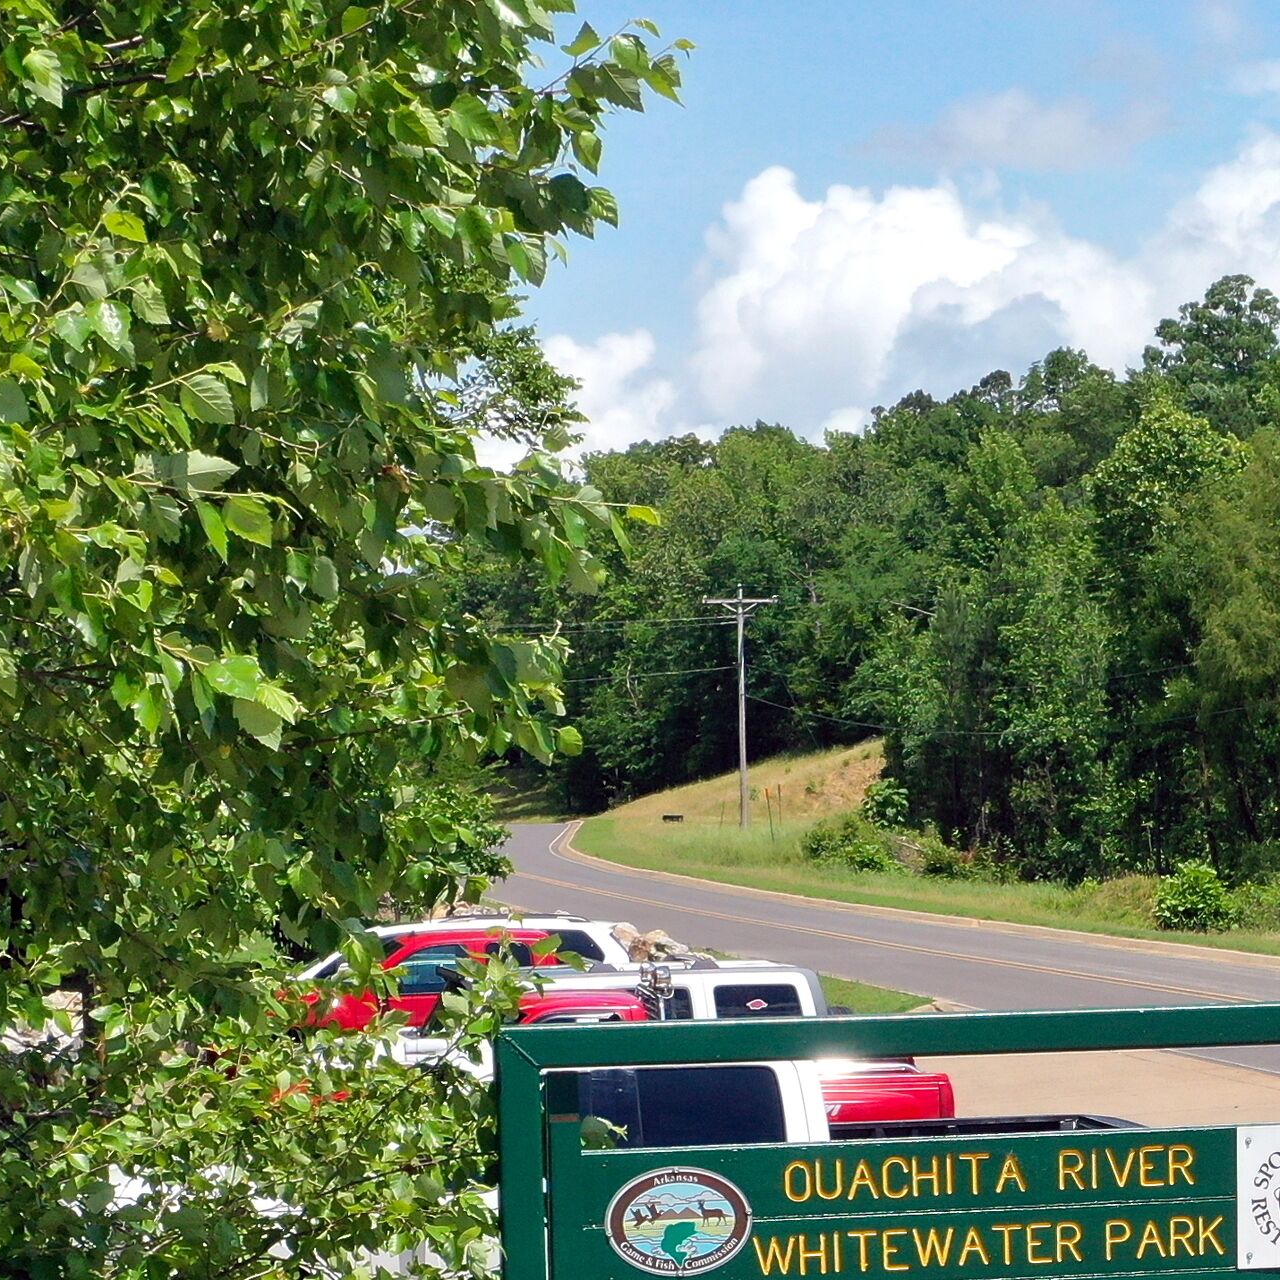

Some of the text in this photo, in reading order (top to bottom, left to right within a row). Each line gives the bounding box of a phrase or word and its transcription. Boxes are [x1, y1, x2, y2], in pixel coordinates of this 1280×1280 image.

[653, 1174, 699, 1187] Arkansas
[784, 1144, 1196, 1203] OUACHITA RIVER
[620, 1238, 738, 1270] Game & Fish Commission
[752, 1215, 1227, 1276] WHITEWATER PARK
